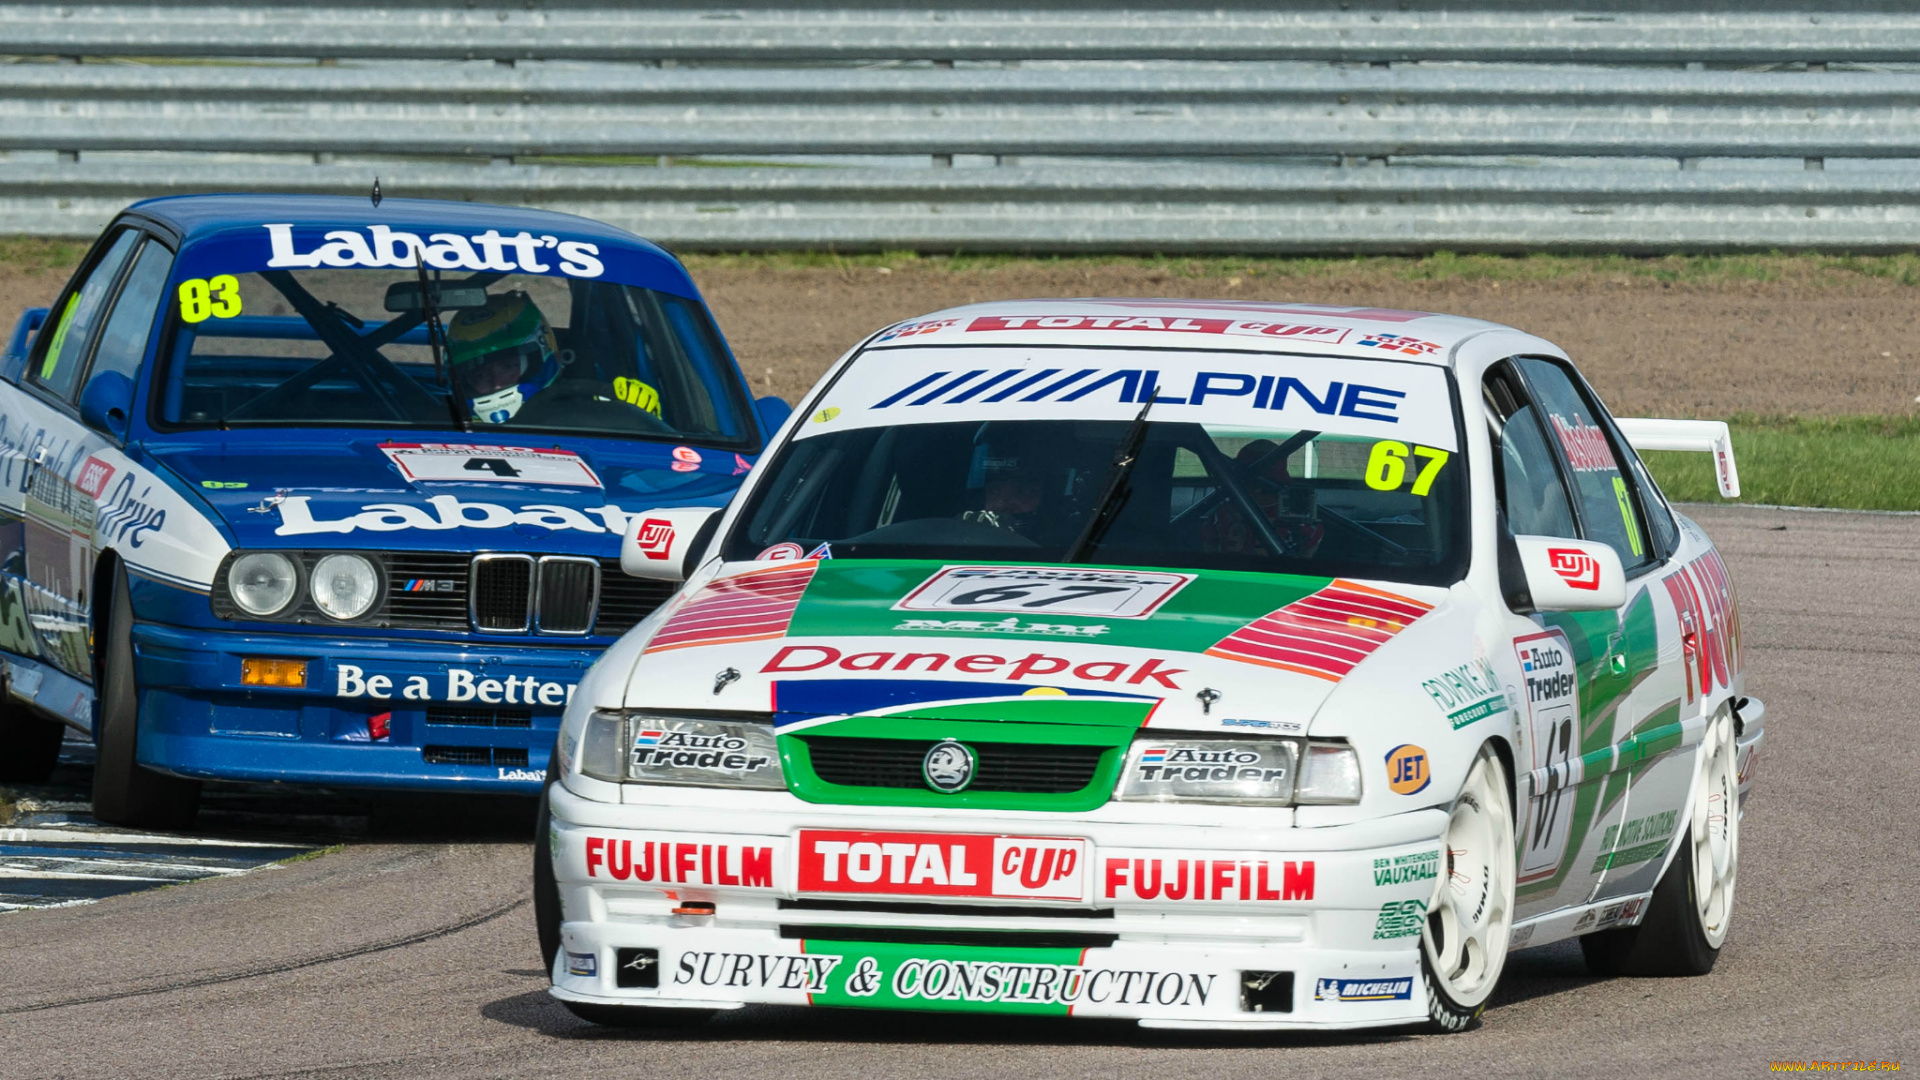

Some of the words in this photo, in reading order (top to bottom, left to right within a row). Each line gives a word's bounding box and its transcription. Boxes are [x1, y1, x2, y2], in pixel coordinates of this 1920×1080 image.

[263, 223, 604, 278] Labatt's
[178, 274, 242, 323] 83
[985, 315, 1204, 332] TOTAL
[1238, 321, 1343, 339] CUP
[1362, 334, 1442, 356] TOTAL
[1052, 369, 1407, 424] ALPINE
[463, 458, 522, 478] 4
[1364, 440, 1449, 496] 67
[264, 494, 638, 537] Labat
[949, 583, 1132, 608] 67
[761, 645, 1189, 690] Danepak
[1531, 646, 1563, 671] Auto
[336, 664, 393, 698] Be
[402, 675, 431, 700] a
[447, 669, 578, 707] Better
[1526, 670, 1574, 703] Trader
[658, 731, 747, 751] Auto
[631, 747, 770, 771] Trader
[1166, 749, 1260, 765] Auto
[1393, 754, 1424, 783] JET
[1136, 764, 1286, 783] Trader
[586, 837, 774, 888] FUJIFILM
[812, 838, 978, 887] TOTAL
[999, 846, 1077, 896] CUP
[1373, 859, 1391, 869] BEN
[1394, 850, 1439, 866] WHITEHOUSE
[1374, 861, 1438, 887] VAUXHALL
[1105, 858, 1315, 901] FUJIFILM
[673, 951, 842, 993] SURVEY
[843, 956, 880, 994] &
[891, 957, 1217, 1005] CONSTRUCTION
[1342, 981, 1411, 996] MICHELIN
